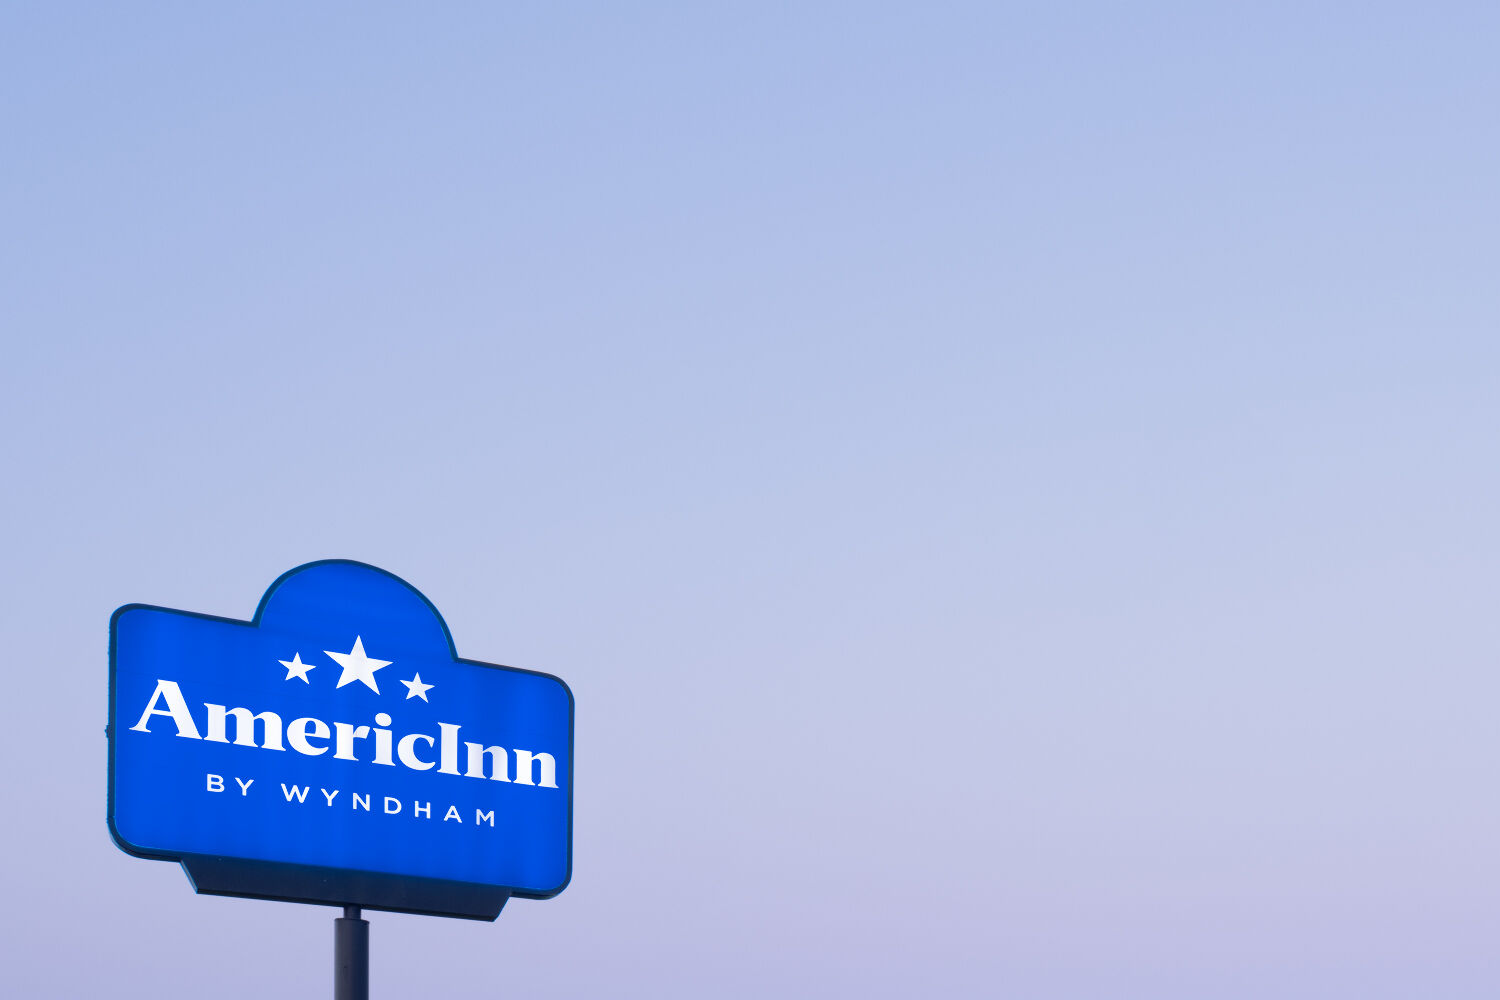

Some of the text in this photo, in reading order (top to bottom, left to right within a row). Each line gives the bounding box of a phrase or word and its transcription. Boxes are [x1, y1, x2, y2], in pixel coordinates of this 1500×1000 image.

[128, 678, 559, 789] AmericInn
[206, 773, 496, 828] BY WYNDHAM
